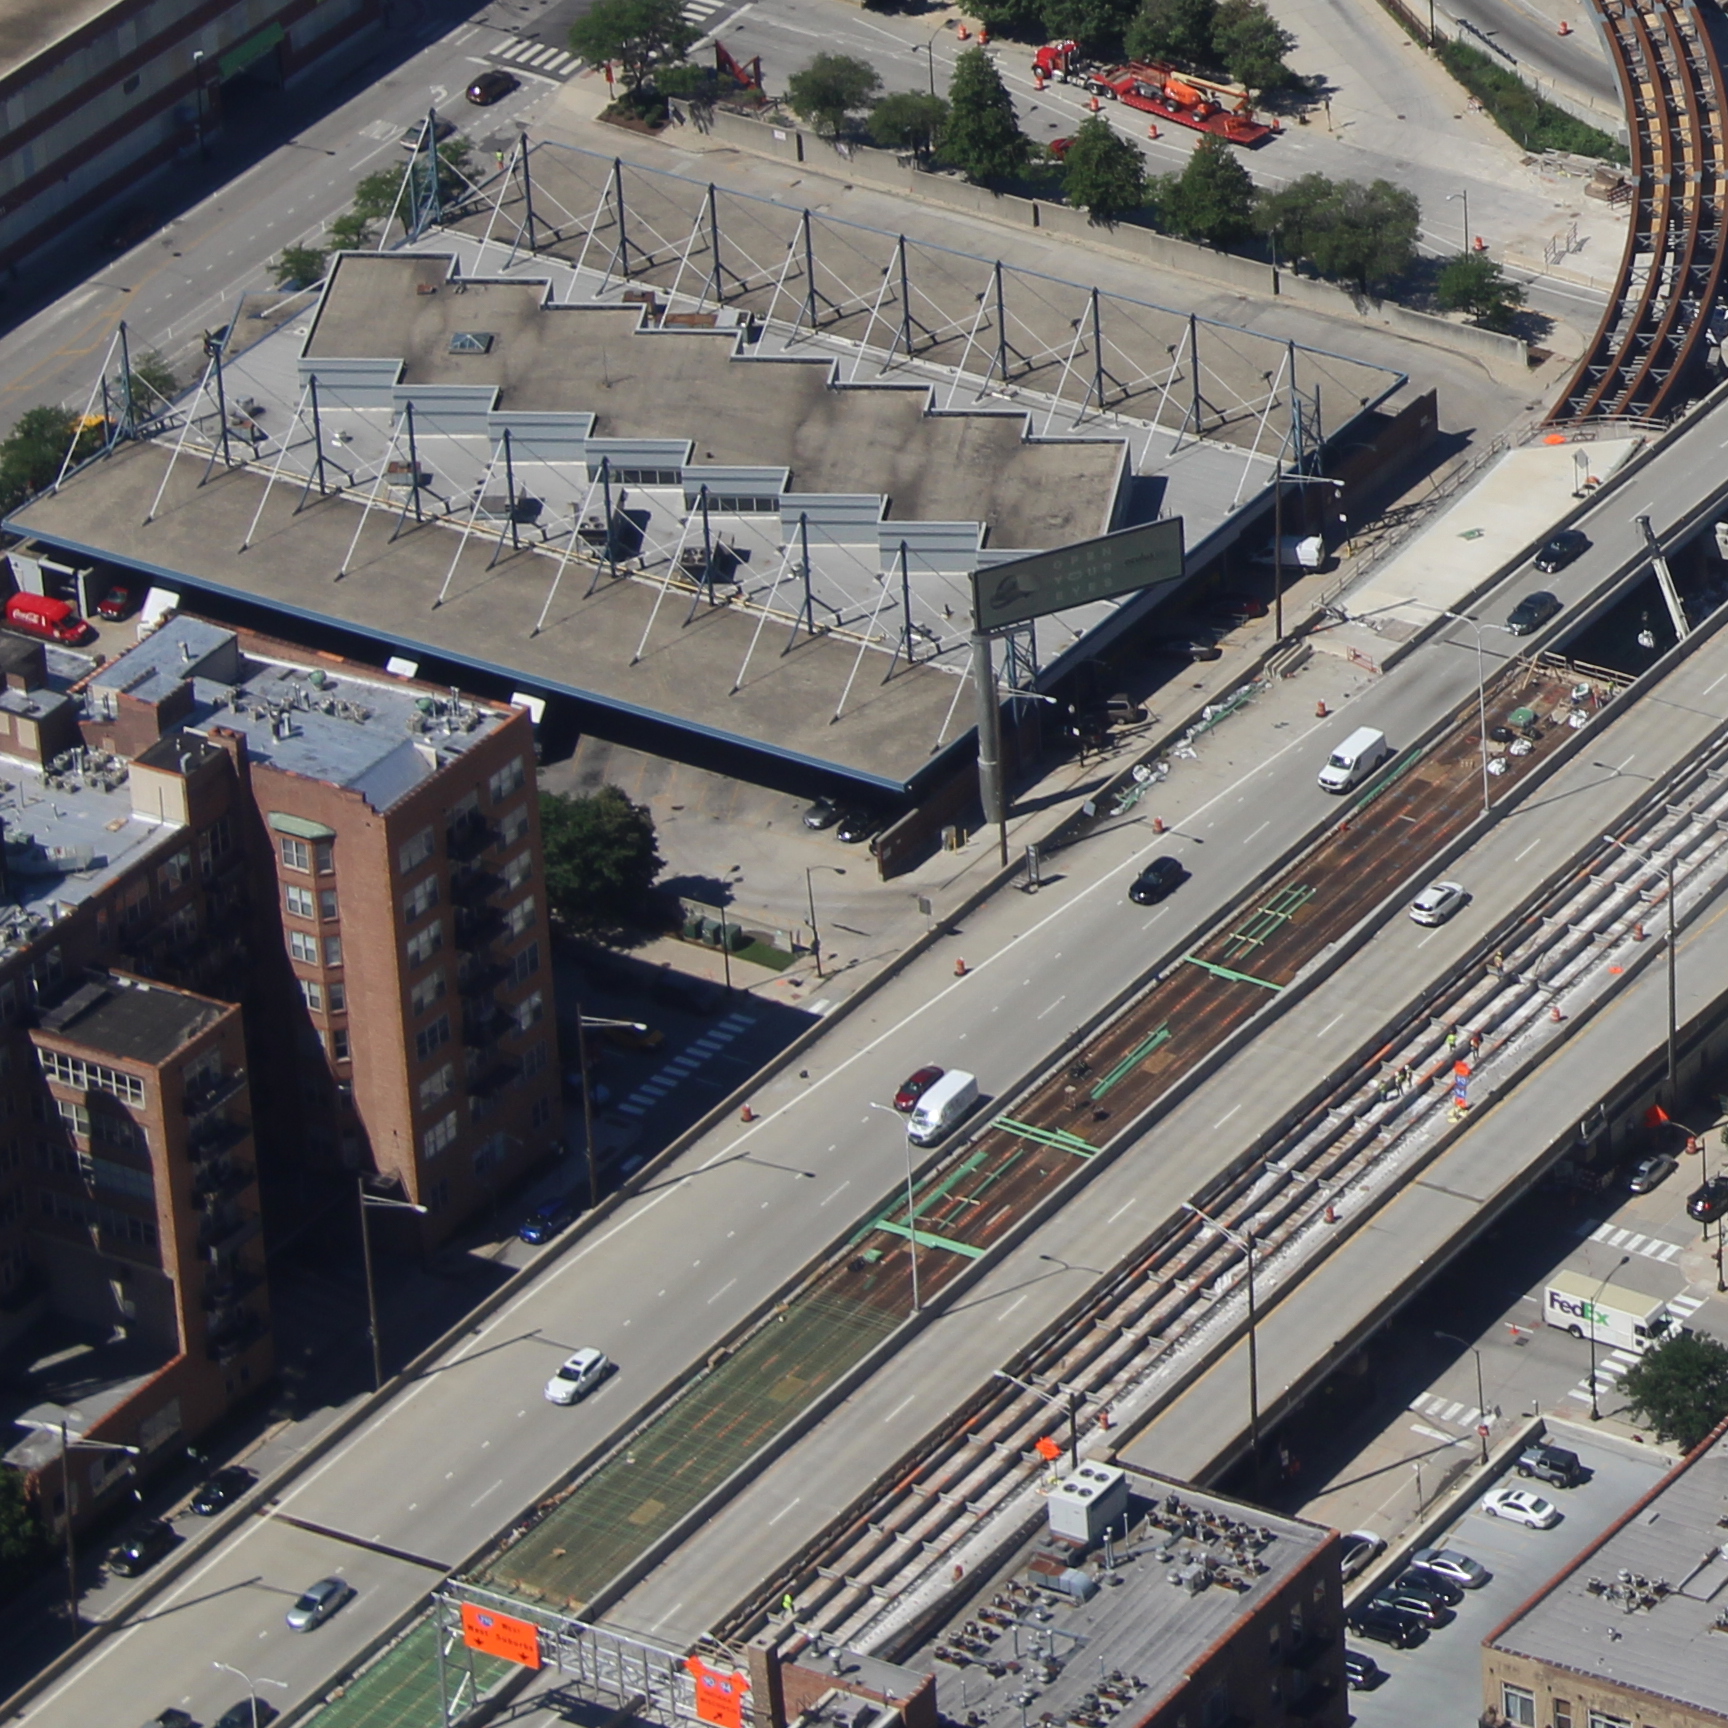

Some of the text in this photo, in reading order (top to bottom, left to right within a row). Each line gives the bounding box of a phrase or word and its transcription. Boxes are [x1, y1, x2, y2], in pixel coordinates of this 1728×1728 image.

[1053, 547, 1111, 569] OPEN
[1056, 577, 1112, 600] EYES
[1549, 1290, 1610, 1327] FedEx
